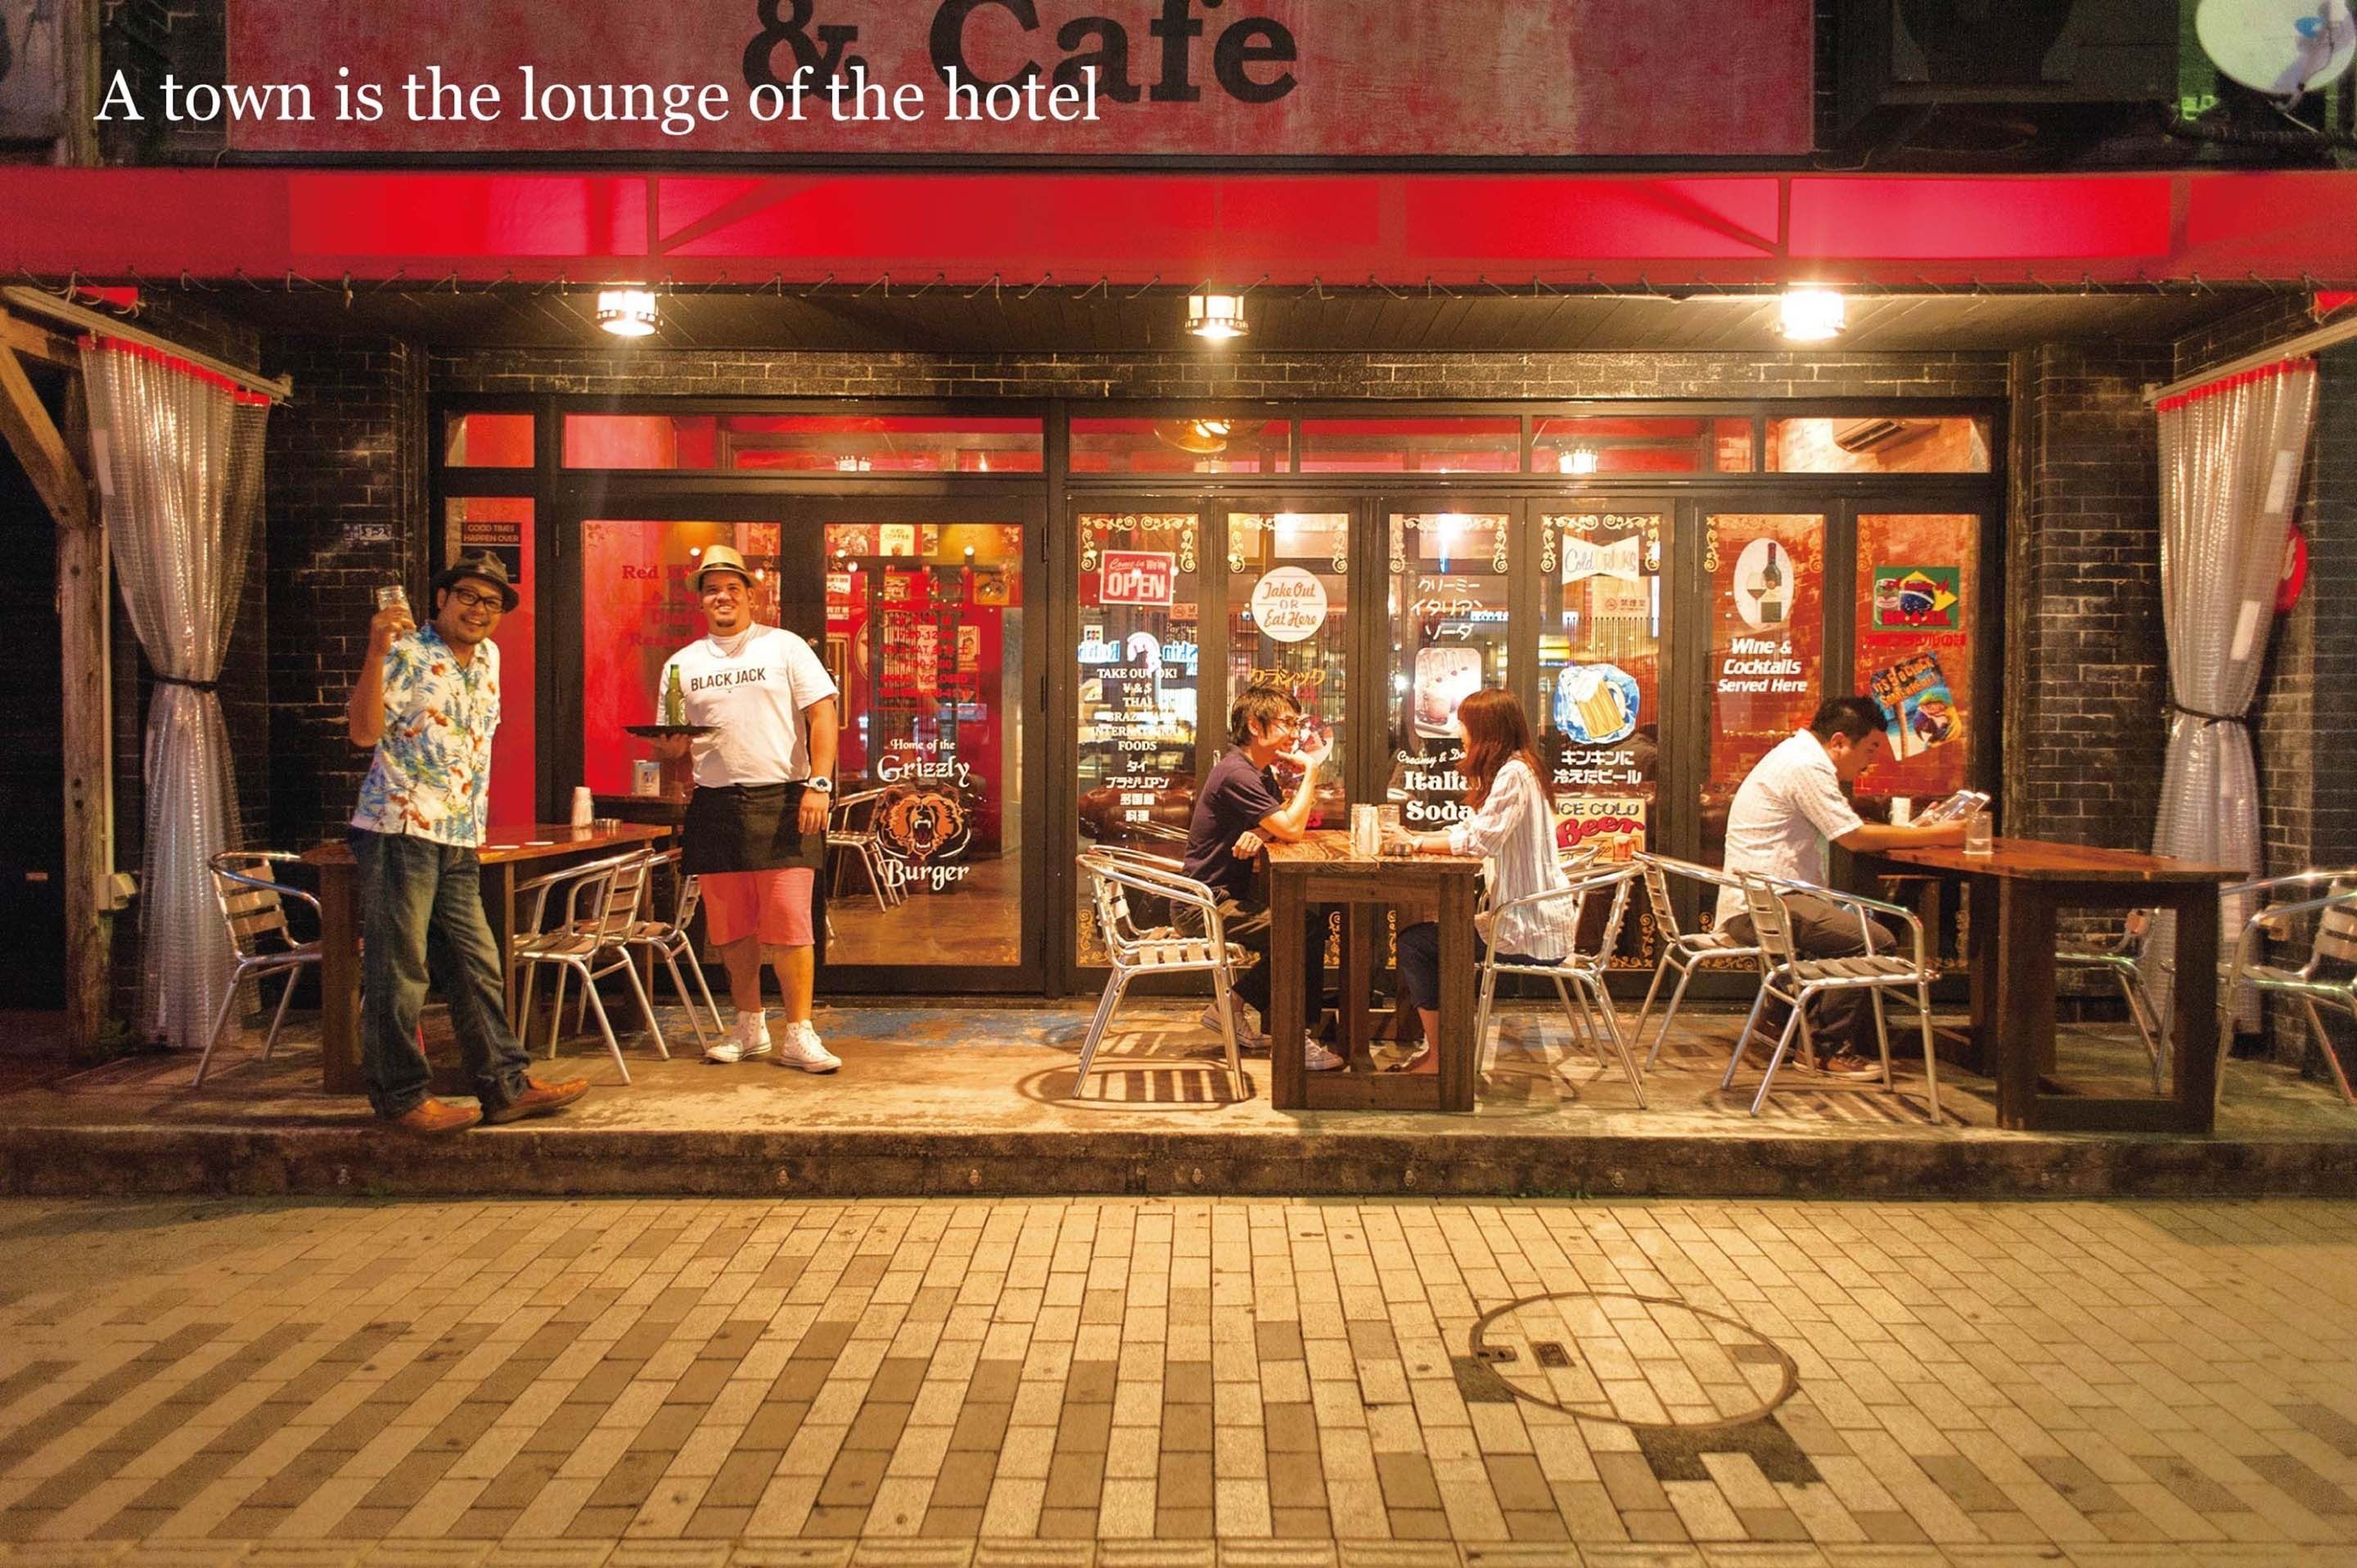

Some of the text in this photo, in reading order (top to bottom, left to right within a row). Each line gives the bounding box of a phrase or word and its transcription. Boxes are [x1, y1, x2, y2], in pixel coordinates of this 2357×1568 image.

[742, 0, 1298, 103] & Cafe
[1565, 547, 1594, 573] Cold
[622, 565, 660, 579] Red
[1106, 572, 1165, 599] OPEN
[1262, 581, 1316, 600] Take Out
[1417, 578, 1480, 593] クリーミー
[1279, 599, 1300, 609] OR
[1264, 609, 1317, 629] Eat Here
[1425, 622, 1475, 641] ソーダ
[1732, 638, 1792, 655] Wine &
[1097, 668, 1128, 679] TAKE
[1723, 658, 1802, 675] Cocktails
[691, 668, 766, 692] BLACK JACK
[1717, 678, 1808, 693] Served Here
[1122, 696, 1152, 708] THAI
[890, 738, 957, 754] Home of the
[1118, 741, 1157, 751] FOODS
[1127, 759, 1148, 773] タイ
[1396, 750, 1438, 769] Creamy
[1439, 751, 1448, 763] &
[1561, 750, 1635, 766] キンキンに
[877, 755, 971, 787] Grizzly
[1553, 768, 1643, 785] 冷えたビール
[1404, 769, 1471, 791] Italia
[1406, 800, 1474, 822] Soda
[1556, 802, 1640, 816] ICE COLD
[1555, 816, 1646, 849] Beer
[877, 858, 971, 891] Burger
